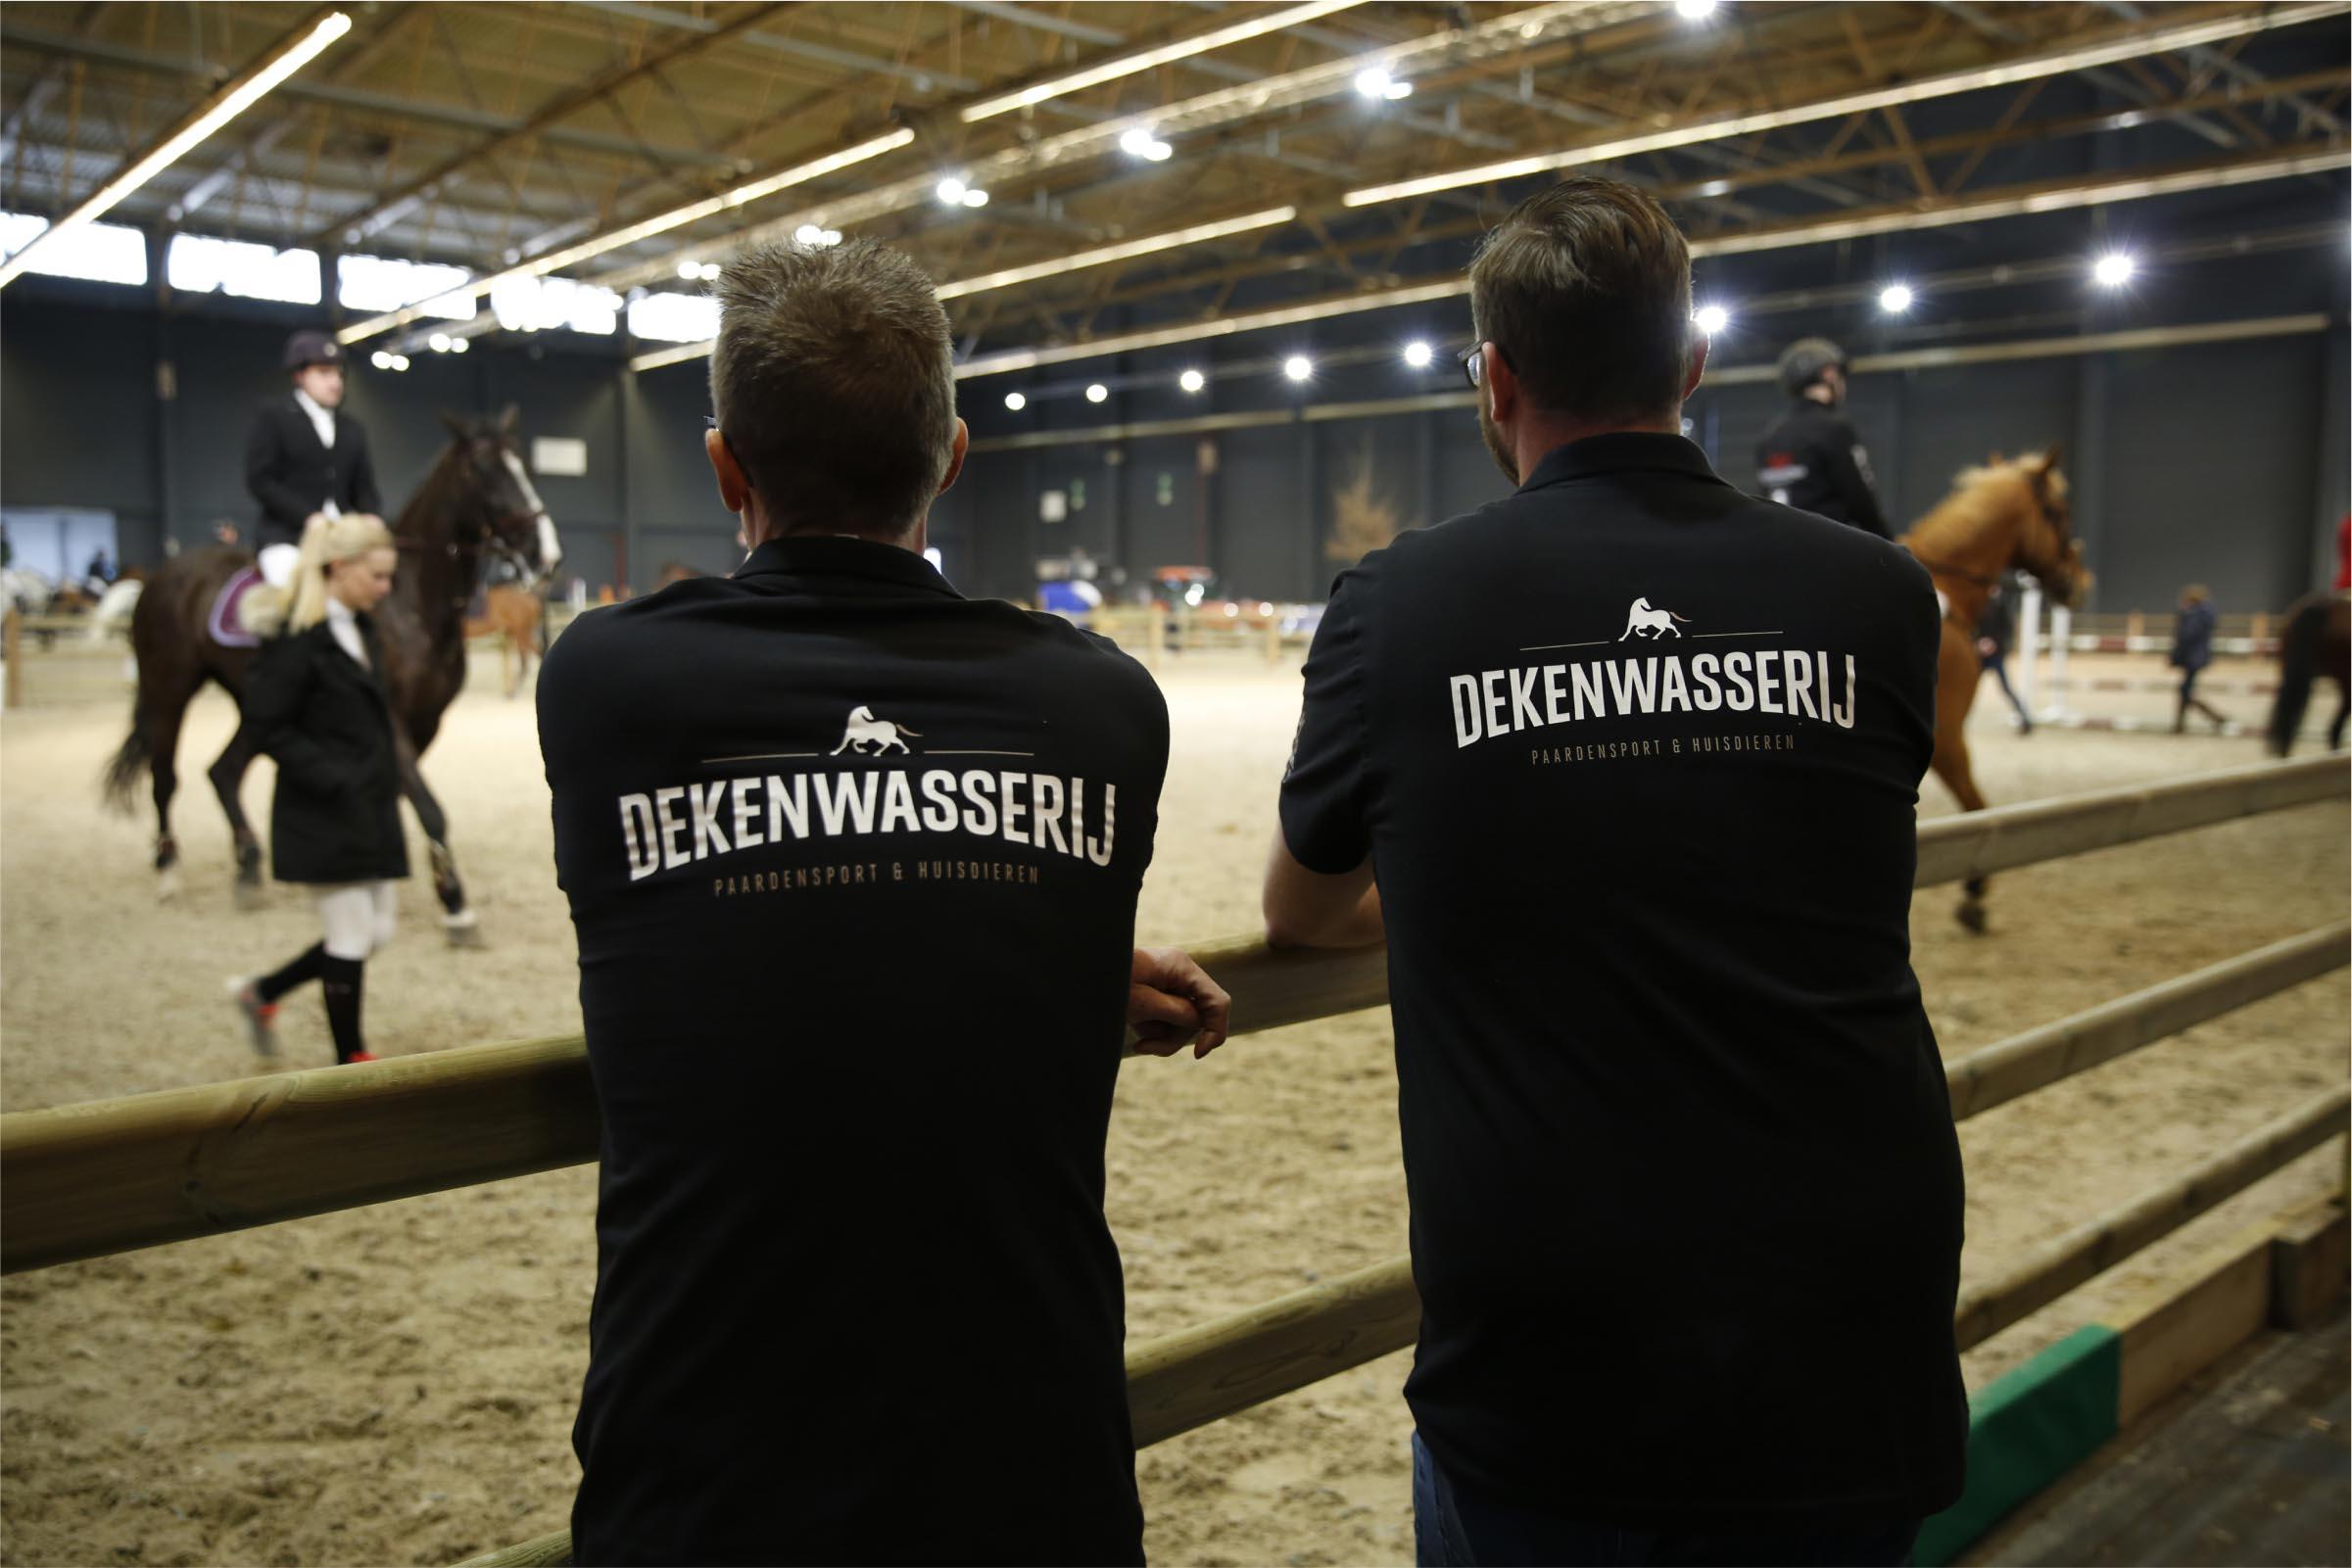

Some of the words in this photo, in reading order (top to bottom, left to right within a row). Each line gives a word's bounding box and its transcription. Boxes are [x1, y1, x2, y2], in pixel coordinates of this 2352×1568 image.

[1449, 649, 1856, 749] DEKENWASSERIJ
[1530, 739, 1660, 765] PAARDENSPORT
[1672, 738, 1681, 754] &
[1692, 735, 1795, 753] HUISDIEREN
[618, 769, 1116, 881] DEKENWASSERIJ
[714, 863, 878, 896] PAARDENSPORT
[892, 862, 902, 880] &
[919, 860, 1038, 884] HUISDIEREN
